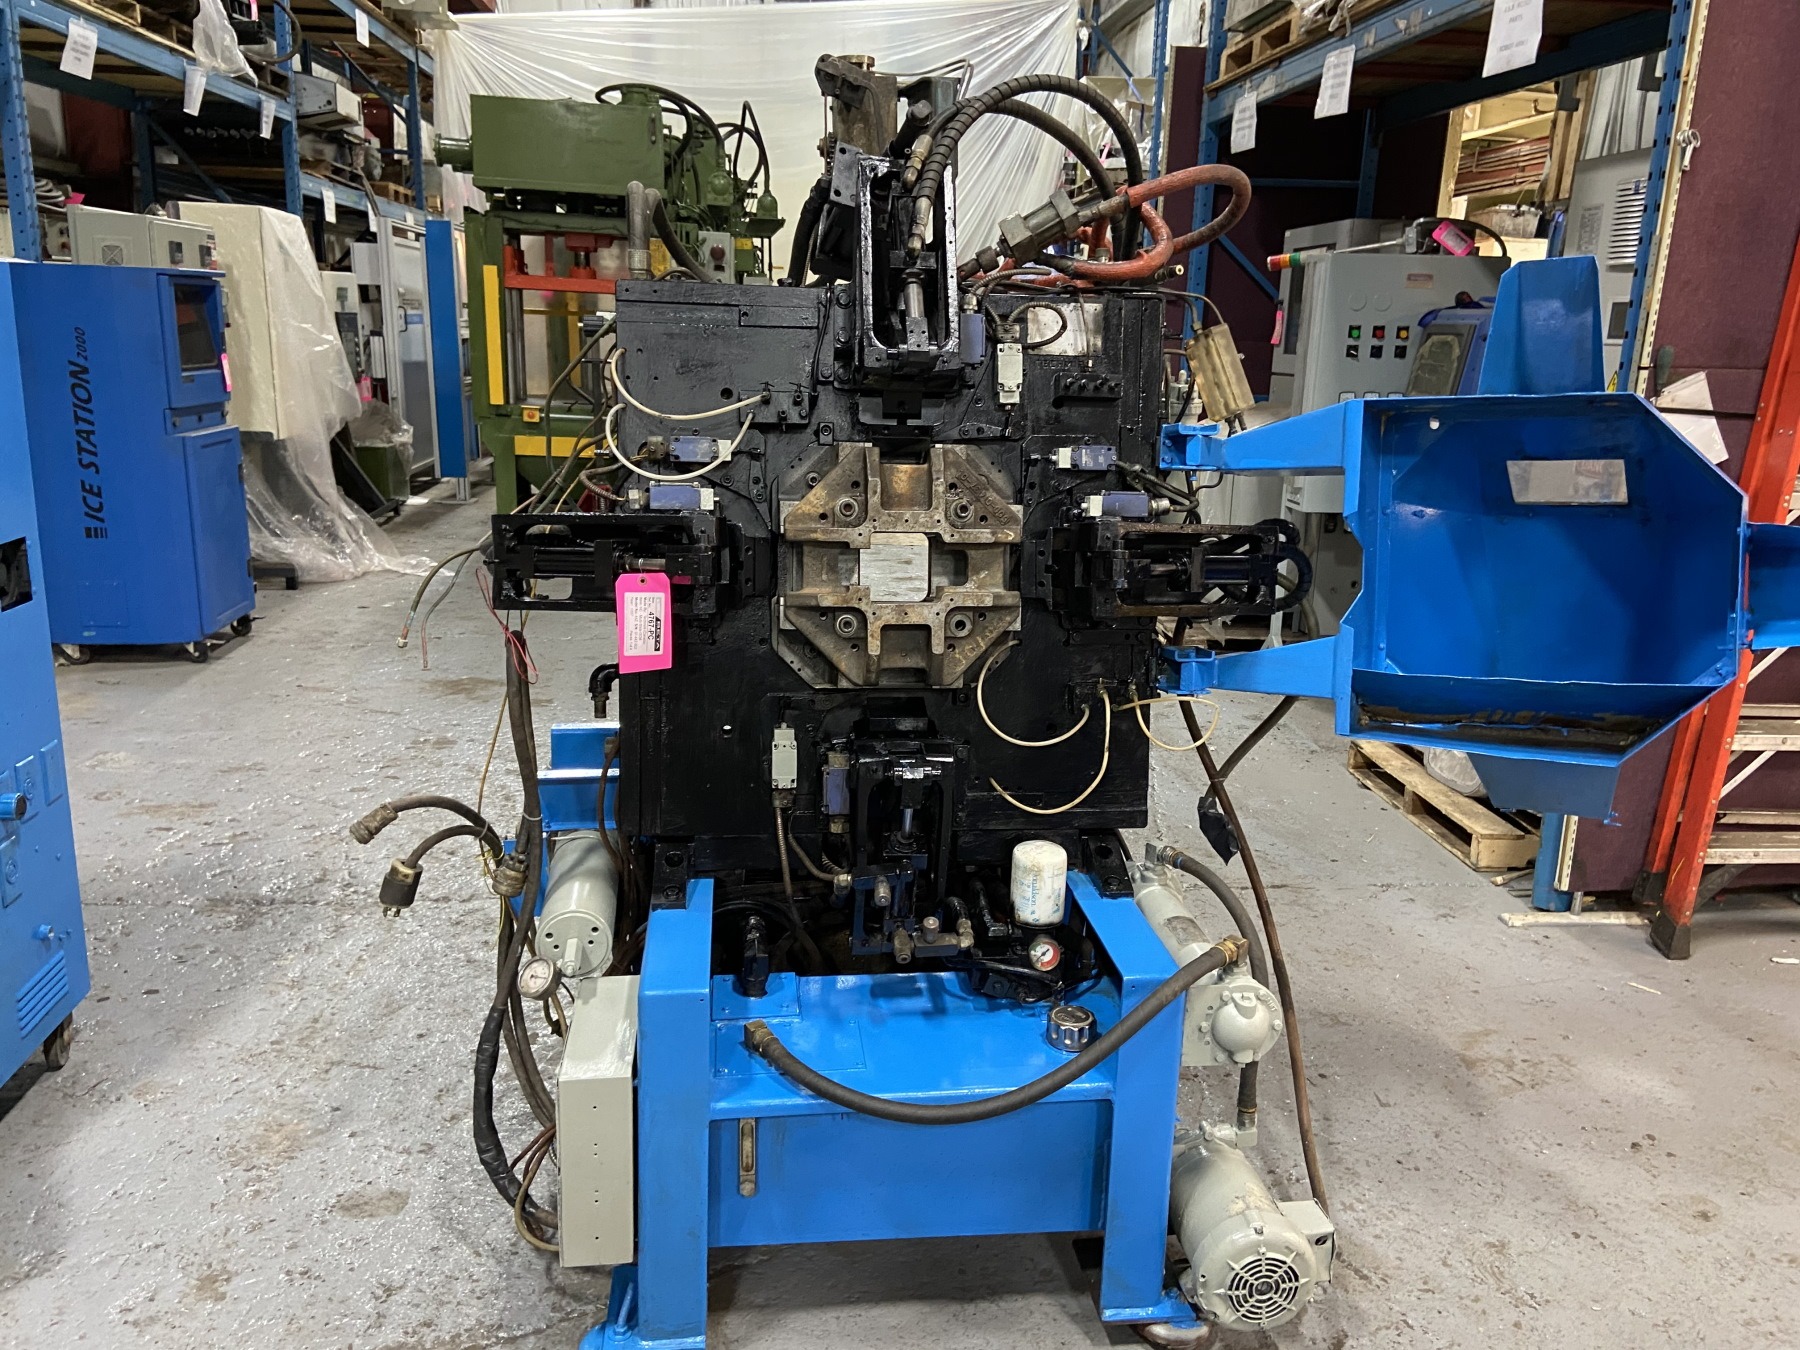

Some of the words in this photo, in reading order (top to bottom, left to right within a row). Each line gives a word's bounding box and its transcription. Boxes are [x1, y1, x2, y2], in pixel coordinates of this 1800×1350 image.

[73, 326, 88, 362] 2000
[67, 359, 100, 475] STATION
[80, 480, 105, 523] ICE
[647, 611, 655, 641] 4767-PC
